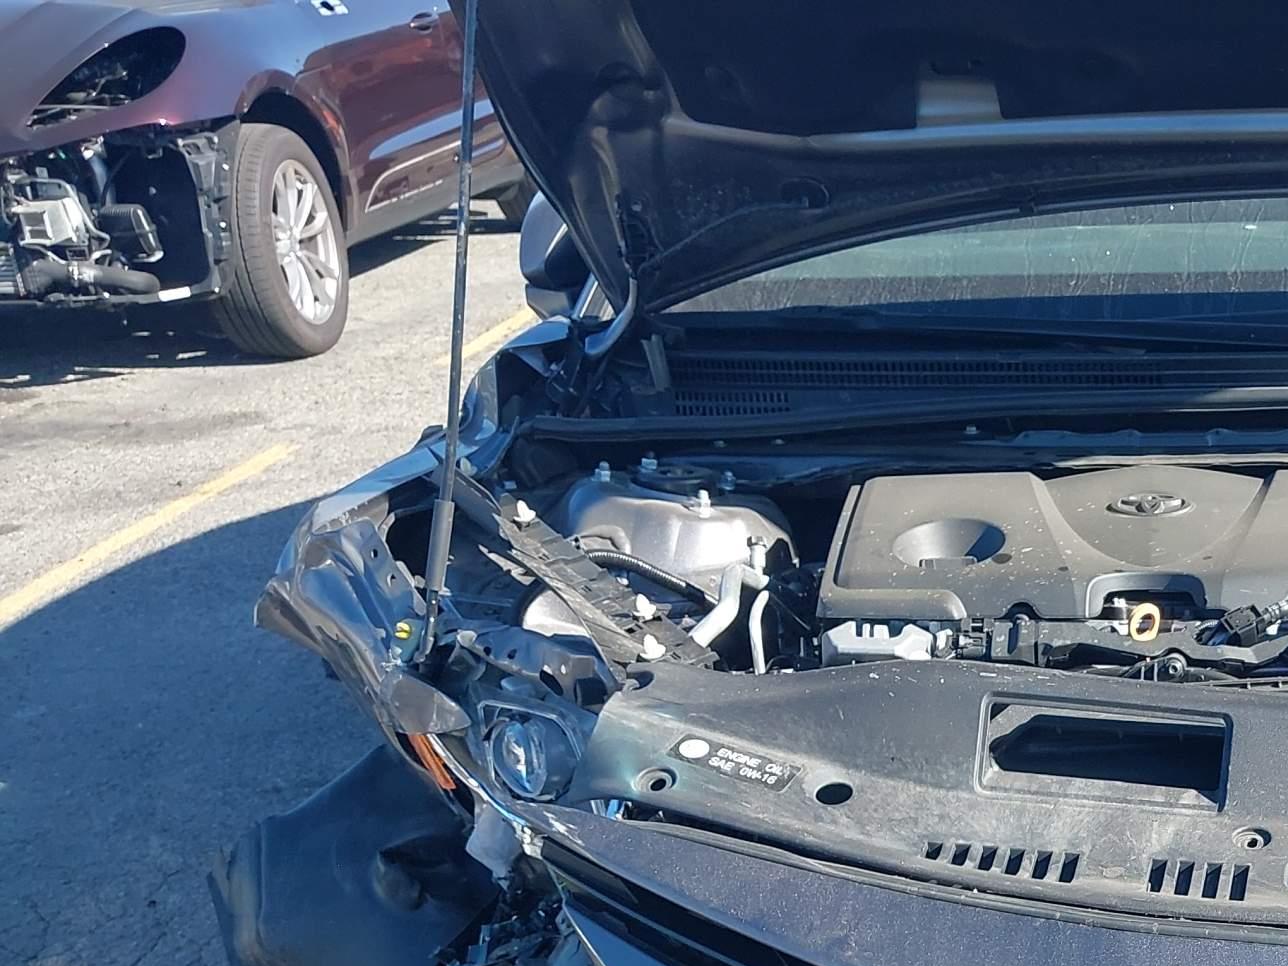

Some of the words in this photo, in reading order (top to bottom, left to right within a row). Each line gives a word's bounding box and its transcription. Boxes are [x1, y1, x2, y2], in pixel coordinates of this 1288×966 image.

[708, 756, 735, 771] SAE
[739, 766, 778, 785] 0W-16
[716, 747, 762, 768] ENGINE
[765, 763, 783, 776] OIL
